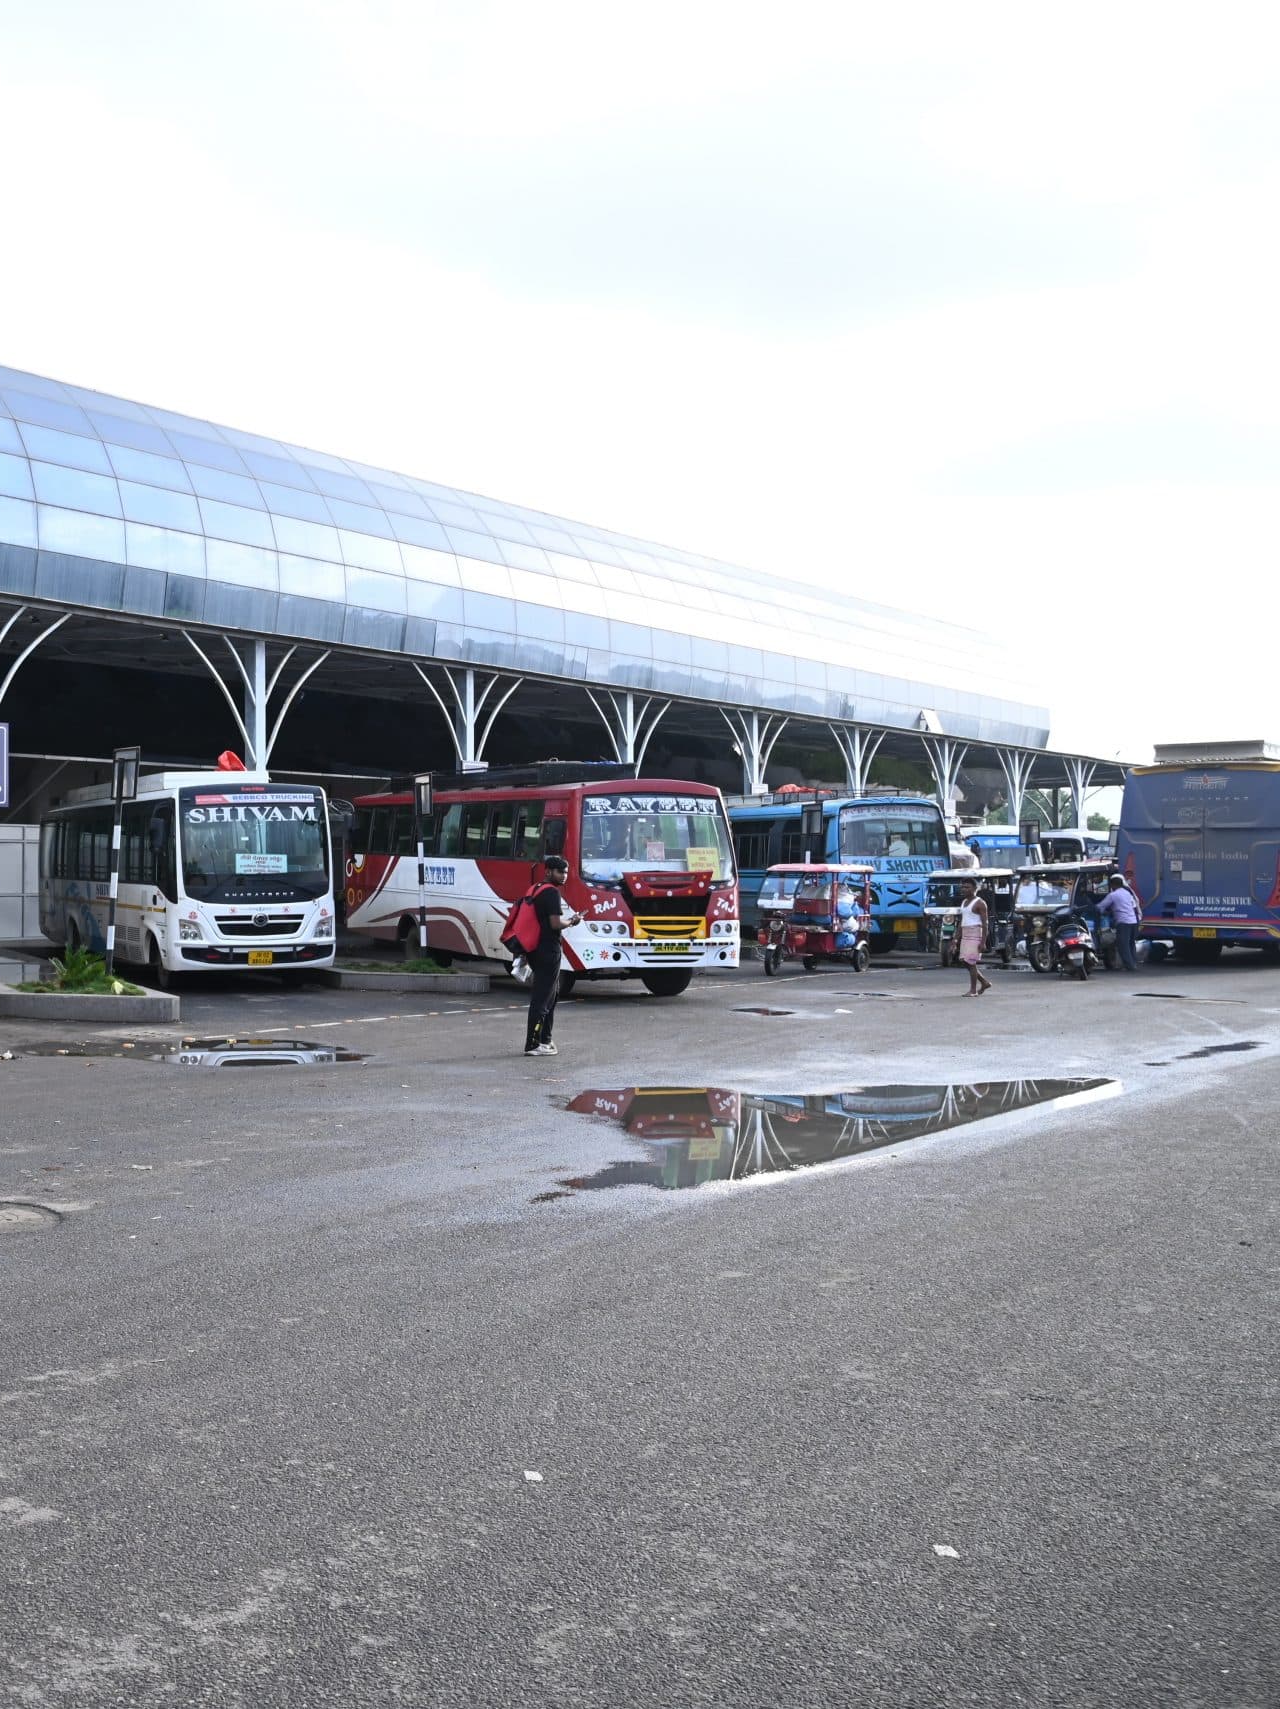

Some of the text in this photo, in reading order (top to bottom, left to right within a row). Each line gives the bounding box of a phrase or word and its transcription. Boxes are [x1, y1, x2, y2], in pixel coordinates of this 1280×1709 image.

[585, 797, 717, 814] RAYEEN
[188, 806, 318, 824] SHIVAM
[1221, 852, 1248, 860] India
[886, 860, 934, 872] SHAKTI
[425, 866, 455, 886] AYEEN
[594, 898, 617, 914] RAJ
[717, 898, 735, 913] TAJ
[1179, 896, 1251, 906] SHIVAM BUS SERVICE
